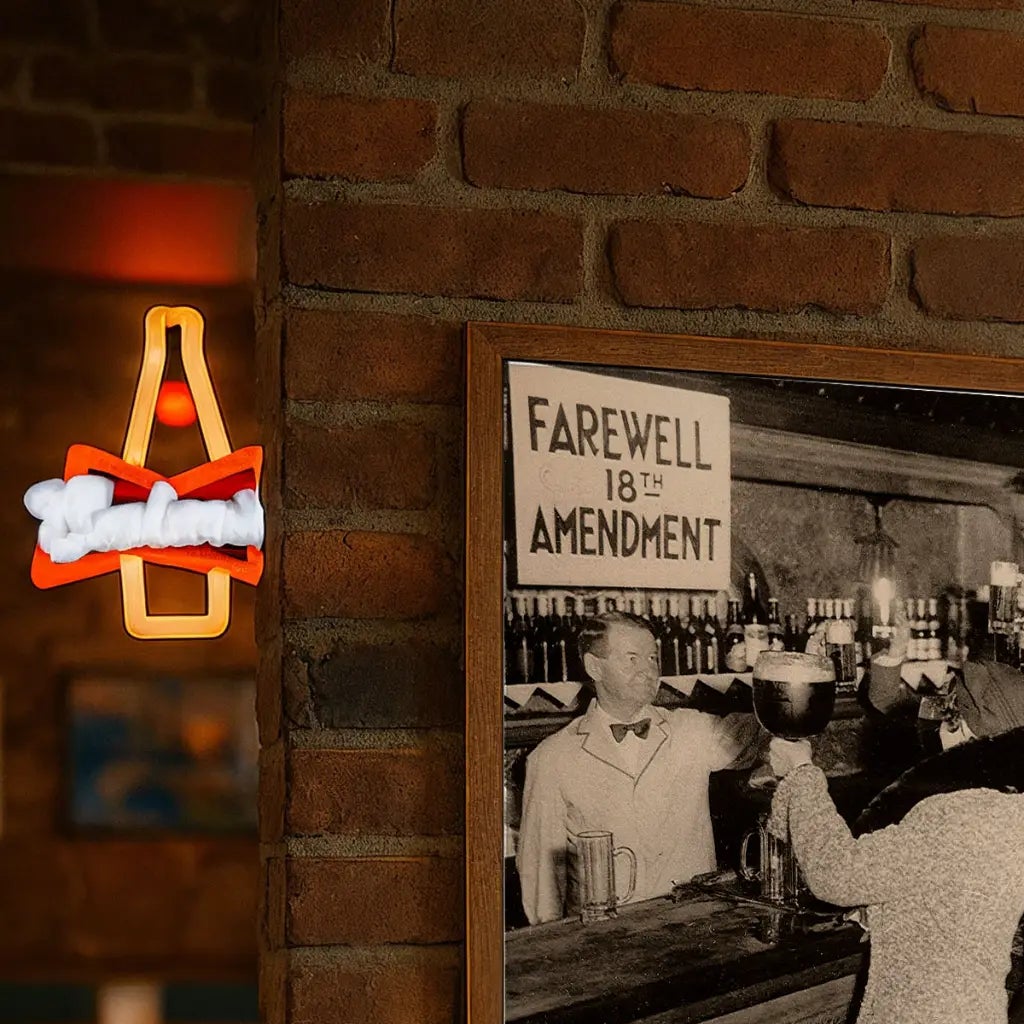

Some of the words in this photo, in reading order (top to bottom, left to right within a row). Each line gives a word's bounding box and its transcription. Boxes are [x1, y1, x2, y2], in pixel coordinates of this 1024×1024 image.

[527, 396, 712, 470] FAREWELL
[606, 469, 663, 503] 18TH
[529, 504, 721, 561] AMENDMENT
